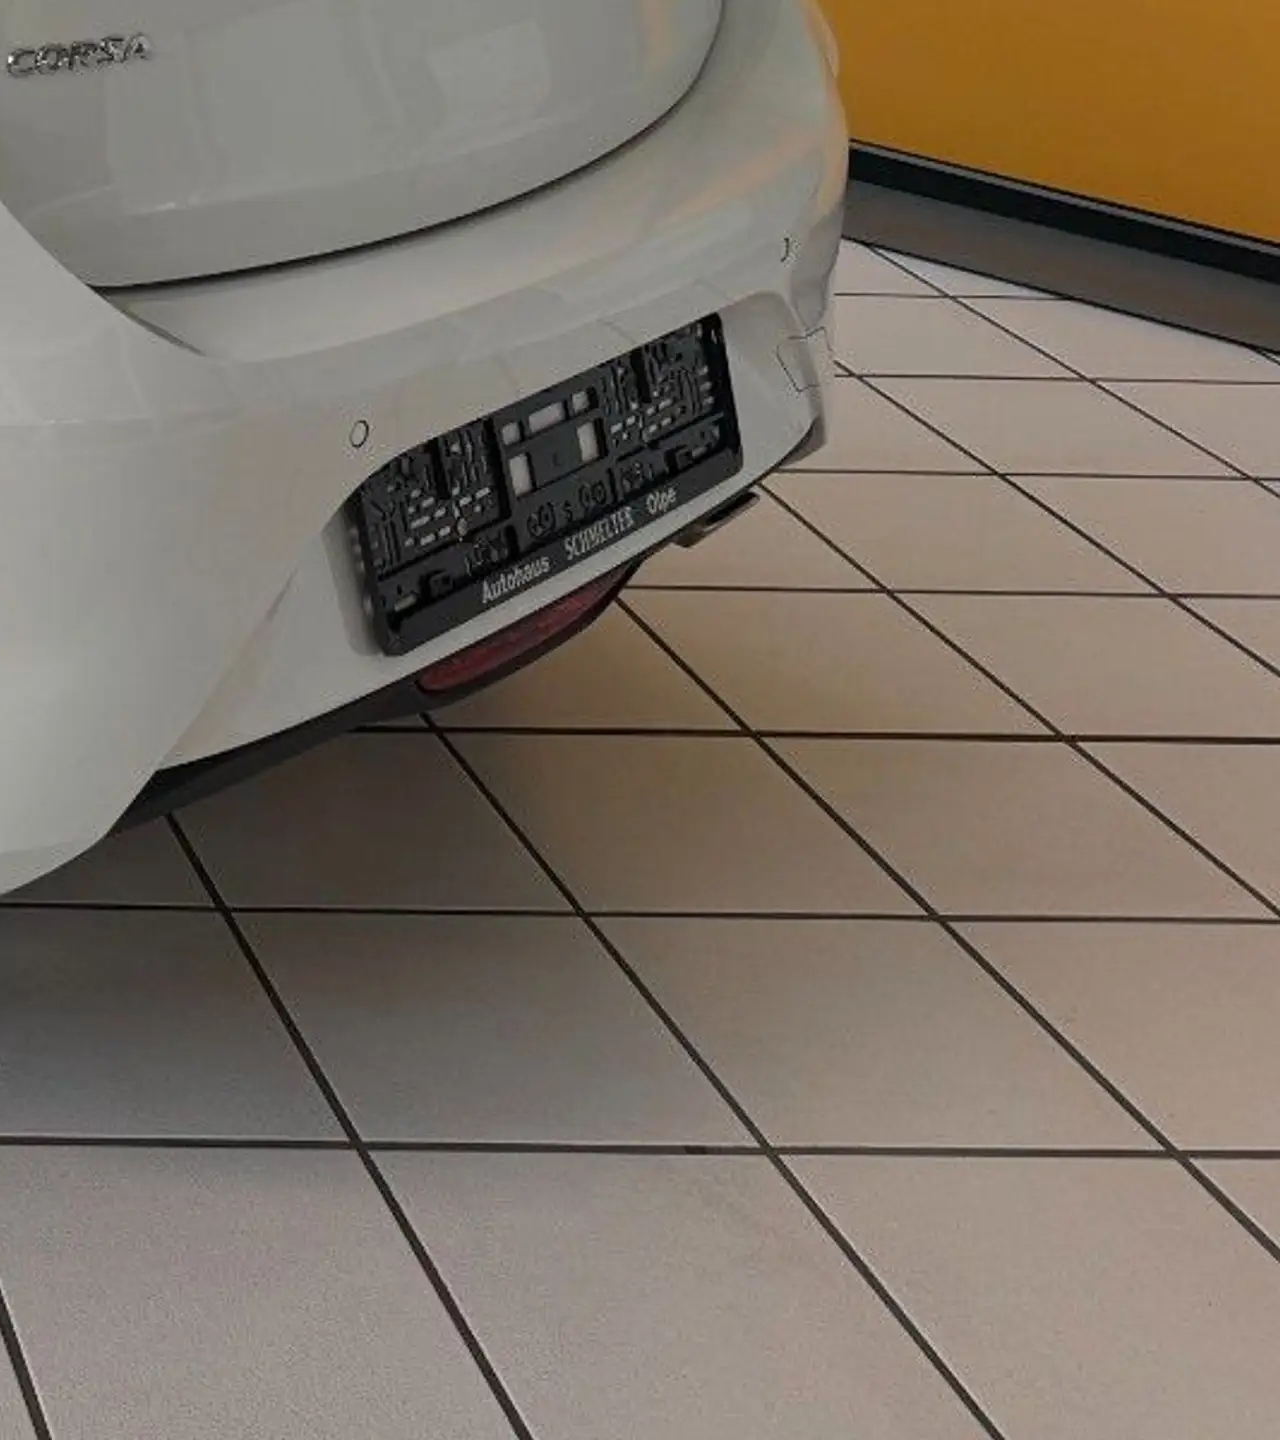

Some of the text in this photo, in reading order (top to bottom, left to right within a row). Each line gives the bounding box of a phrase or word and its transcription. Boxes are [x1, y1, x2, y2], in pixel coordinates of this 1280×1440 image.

[6, 33, 151, 77] CORSA
[482, 487, 678, 603] Autohaus SCHMELTER Olpe
